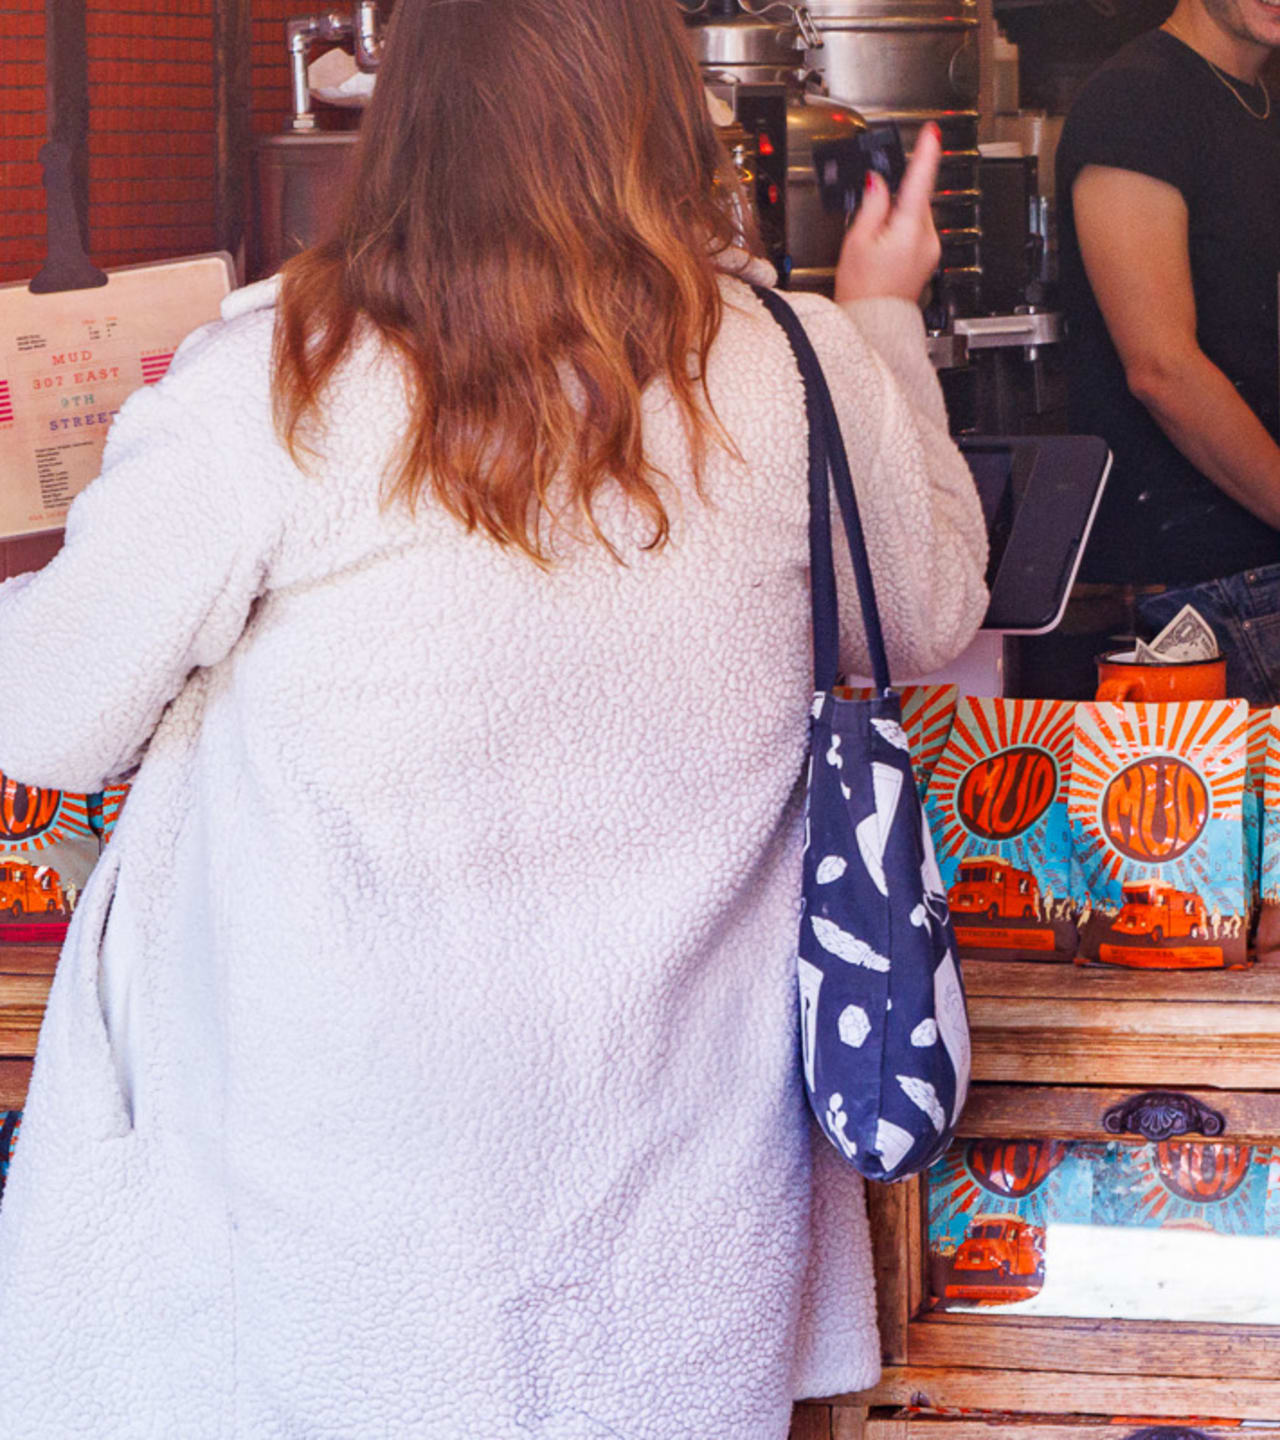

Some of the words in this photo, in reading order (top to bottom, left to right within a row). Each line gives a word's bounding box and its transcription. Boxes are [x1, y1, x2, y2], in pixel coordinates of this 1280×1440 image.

[51, 350, 93, 366] MUD
[73, 367, 120, 385] EAST
[962, 753, 1055, 835] MUD
[1107, 763, 1207, 857] MUD
